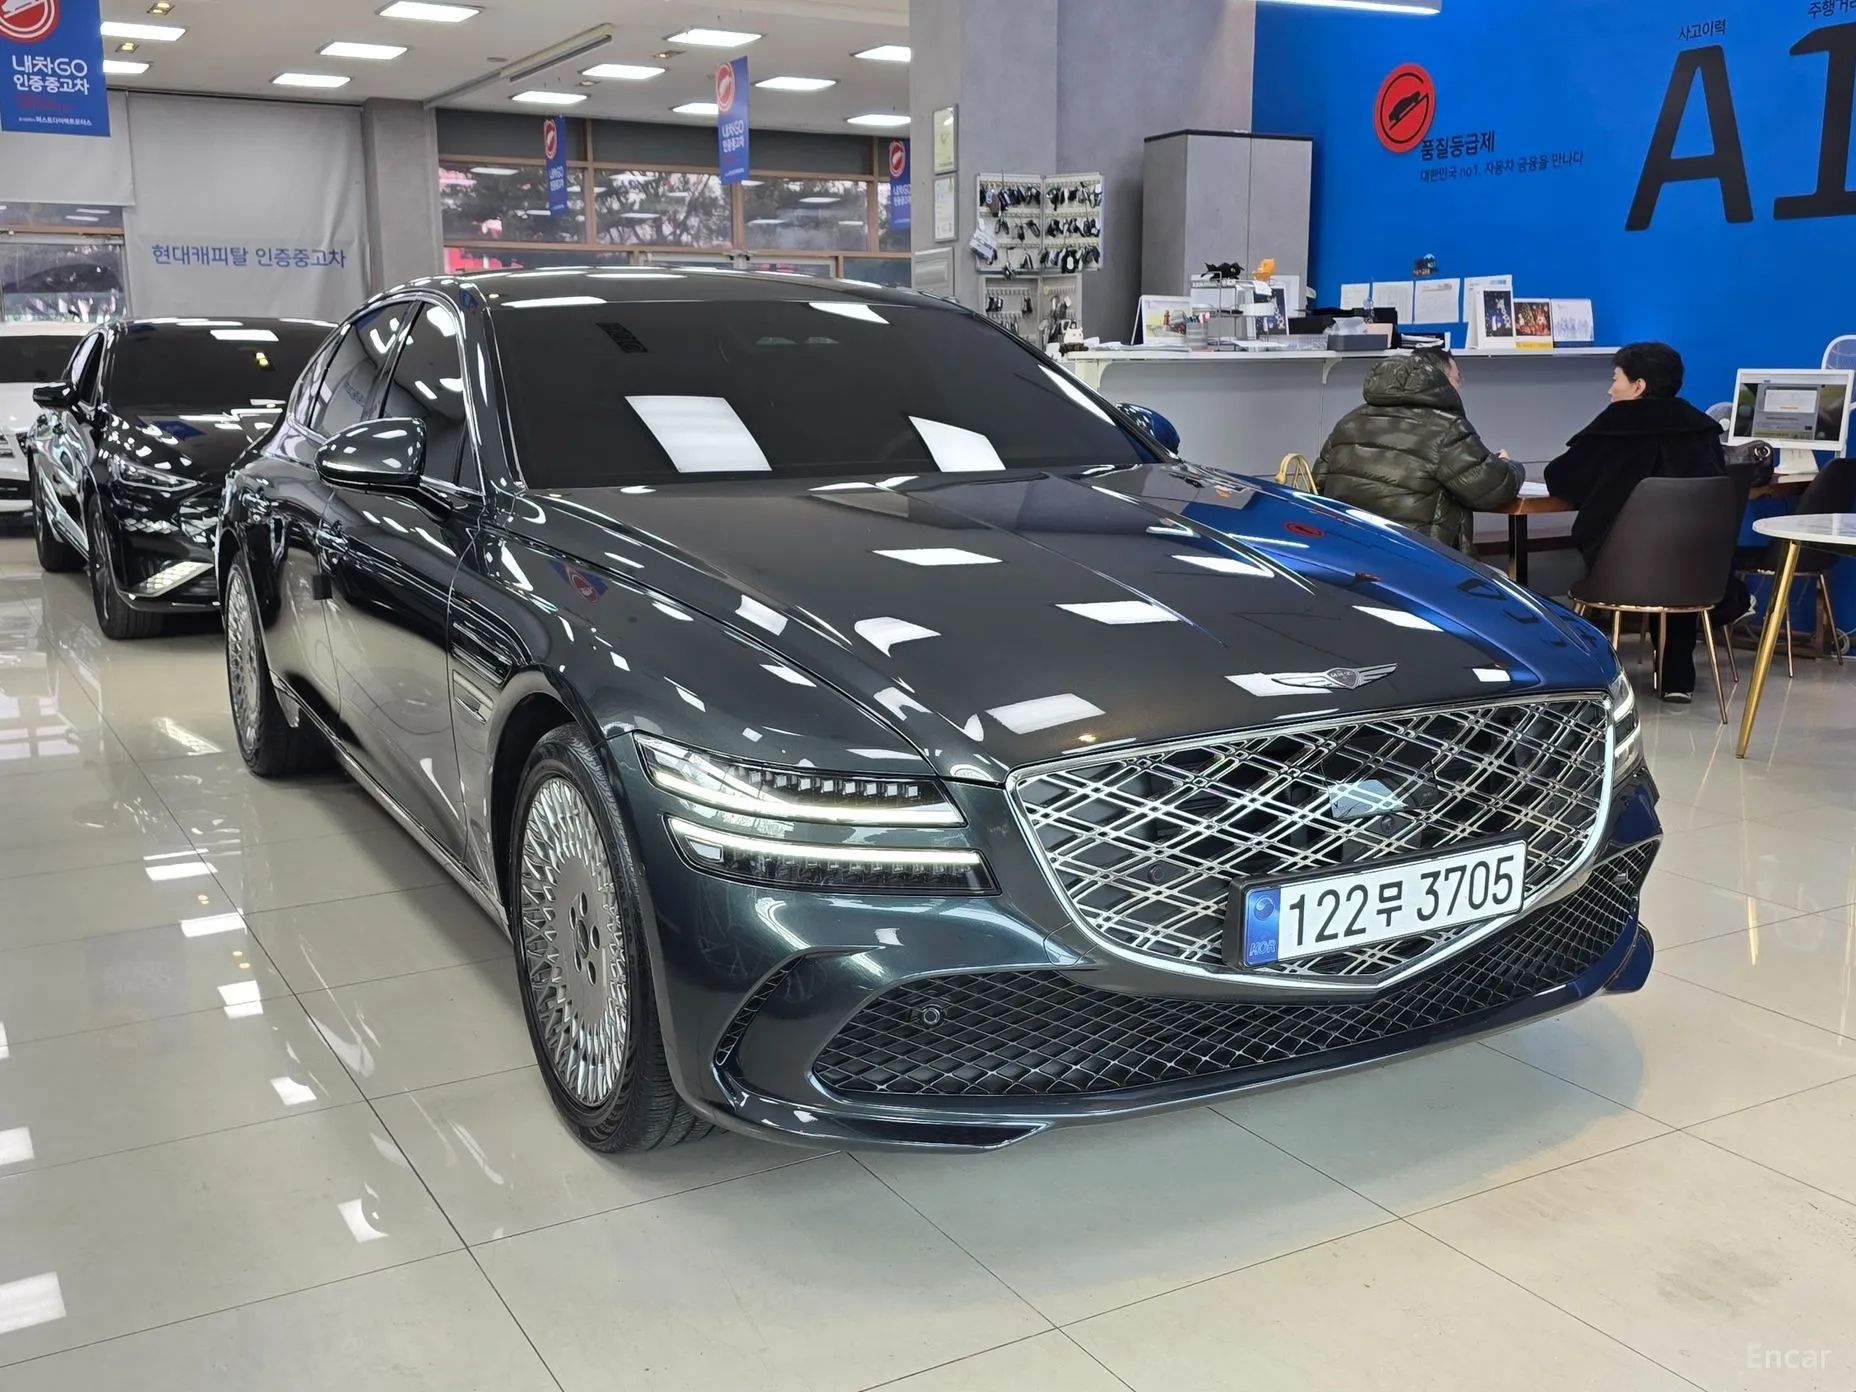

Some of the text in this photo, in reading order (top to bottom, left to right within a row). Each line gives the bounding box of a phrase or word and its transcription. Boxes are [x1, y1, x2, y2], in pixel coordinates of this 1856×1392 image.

[1678, 19, 1726, 41] 사고이력
[12, 54, 88, 77] 내차GO
[13, 74, 90, 95] 인증중고차
[1420, 130, 1495, 161] 품질등급제
[1420, 167, 1458, 183] 대한민국
[1484, 158, 1514, 176] 자동차
[1517, 154, 1549, 173] 금융을
[1551, 150, 1584, 168] 만나다
[152, 244, 346, 268] 현대캐피탈 인증중고차
[1289, 855, 1515, 947] 122무 3705
[1248, 939, 1276, 957] KOR
